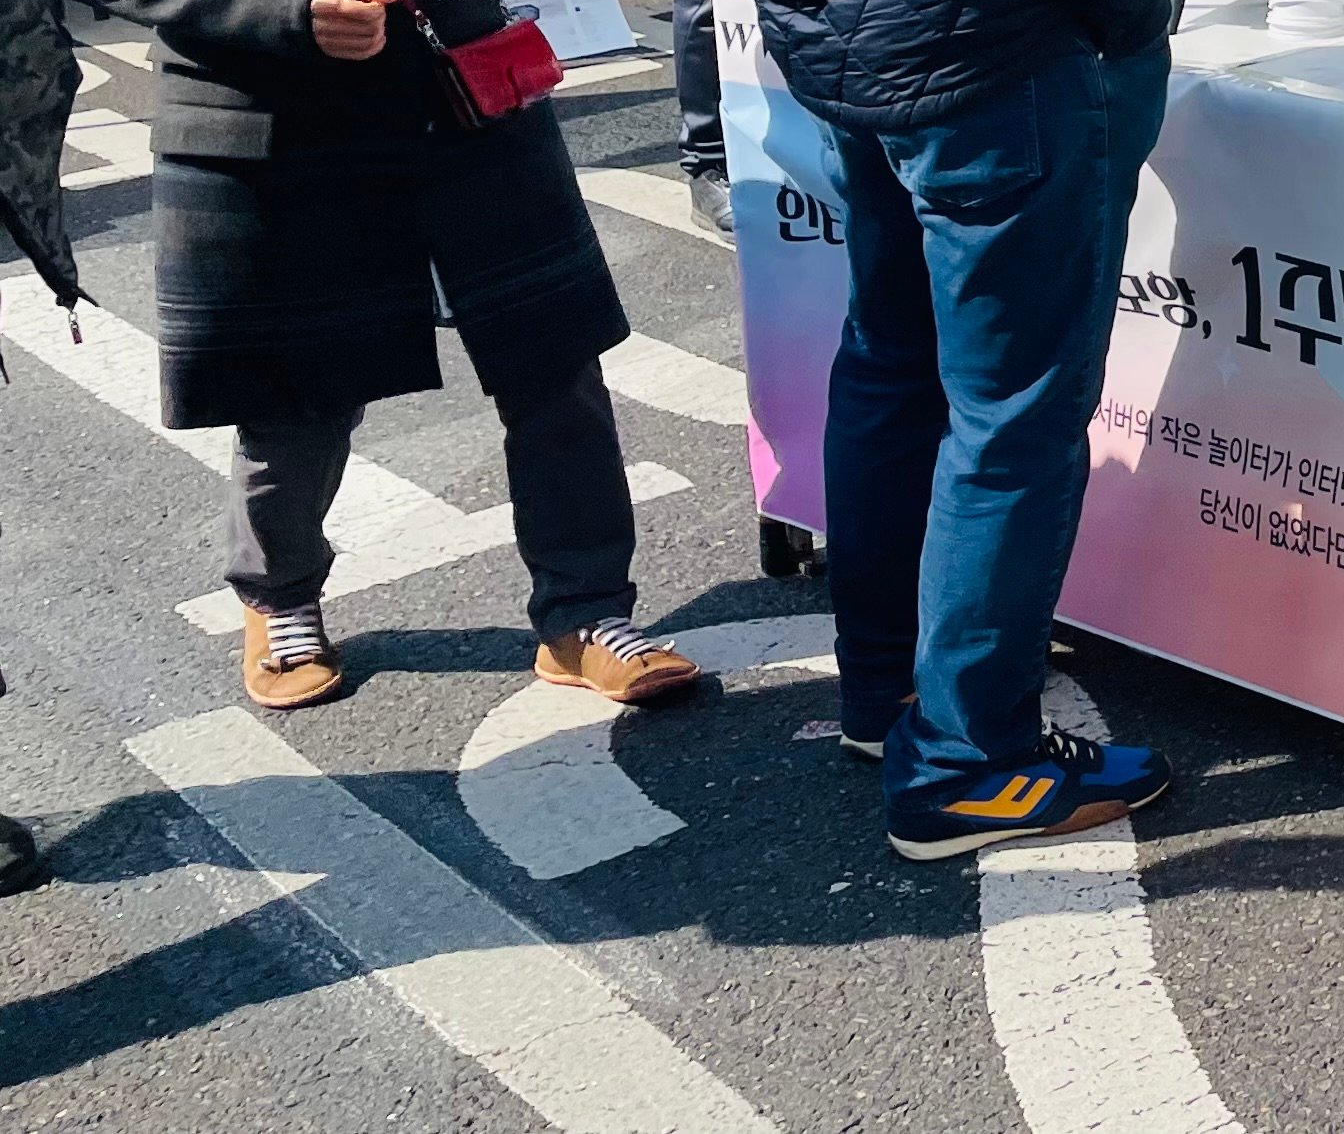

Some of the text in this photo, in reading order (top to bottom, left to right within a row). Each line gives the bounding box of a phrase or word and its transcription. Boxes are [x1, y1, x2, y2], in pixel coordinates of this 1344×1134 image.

[1160, 413, 1204, 461] 작은
[1206, 427, 1294, 492] 놀이터가
[1198, 488, 1264, 544] 당신이
